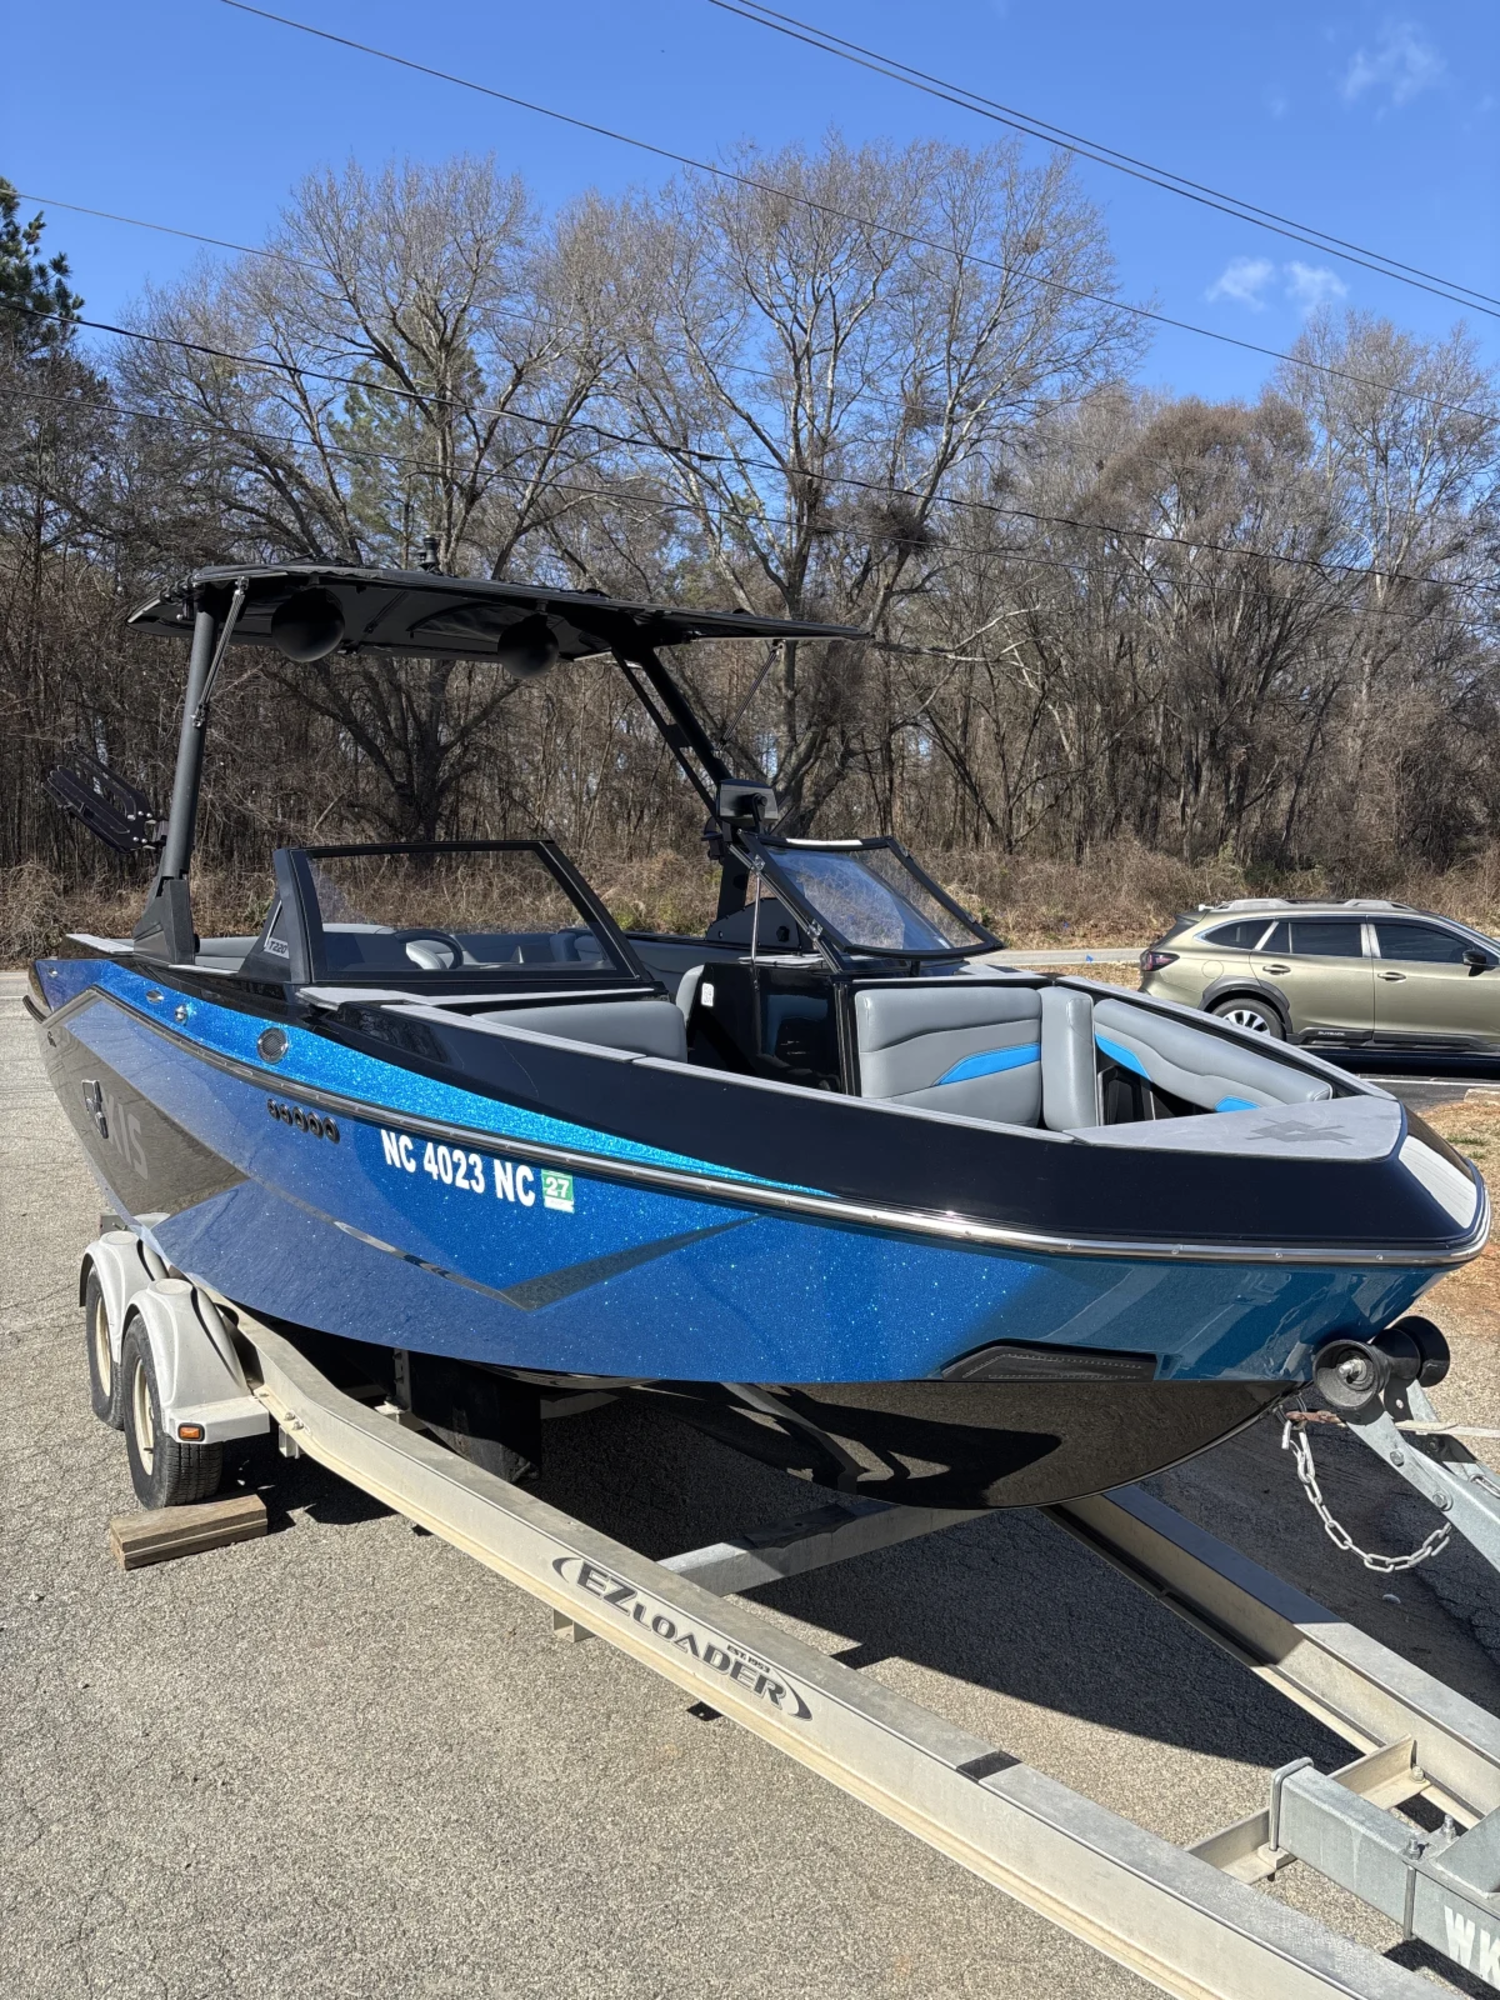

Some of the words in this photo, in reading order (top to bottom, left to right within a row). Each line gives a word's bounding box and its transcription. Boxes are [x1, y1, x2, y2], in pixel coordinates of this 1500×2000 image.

[270, 941, 287, 954] T220
[381, 1129, 416, 1173] NC
[424, 1142, 485, 1194] 4023
[494, 1159, 535, 1207] NC
[545, 1176, 570, 1198] 27
